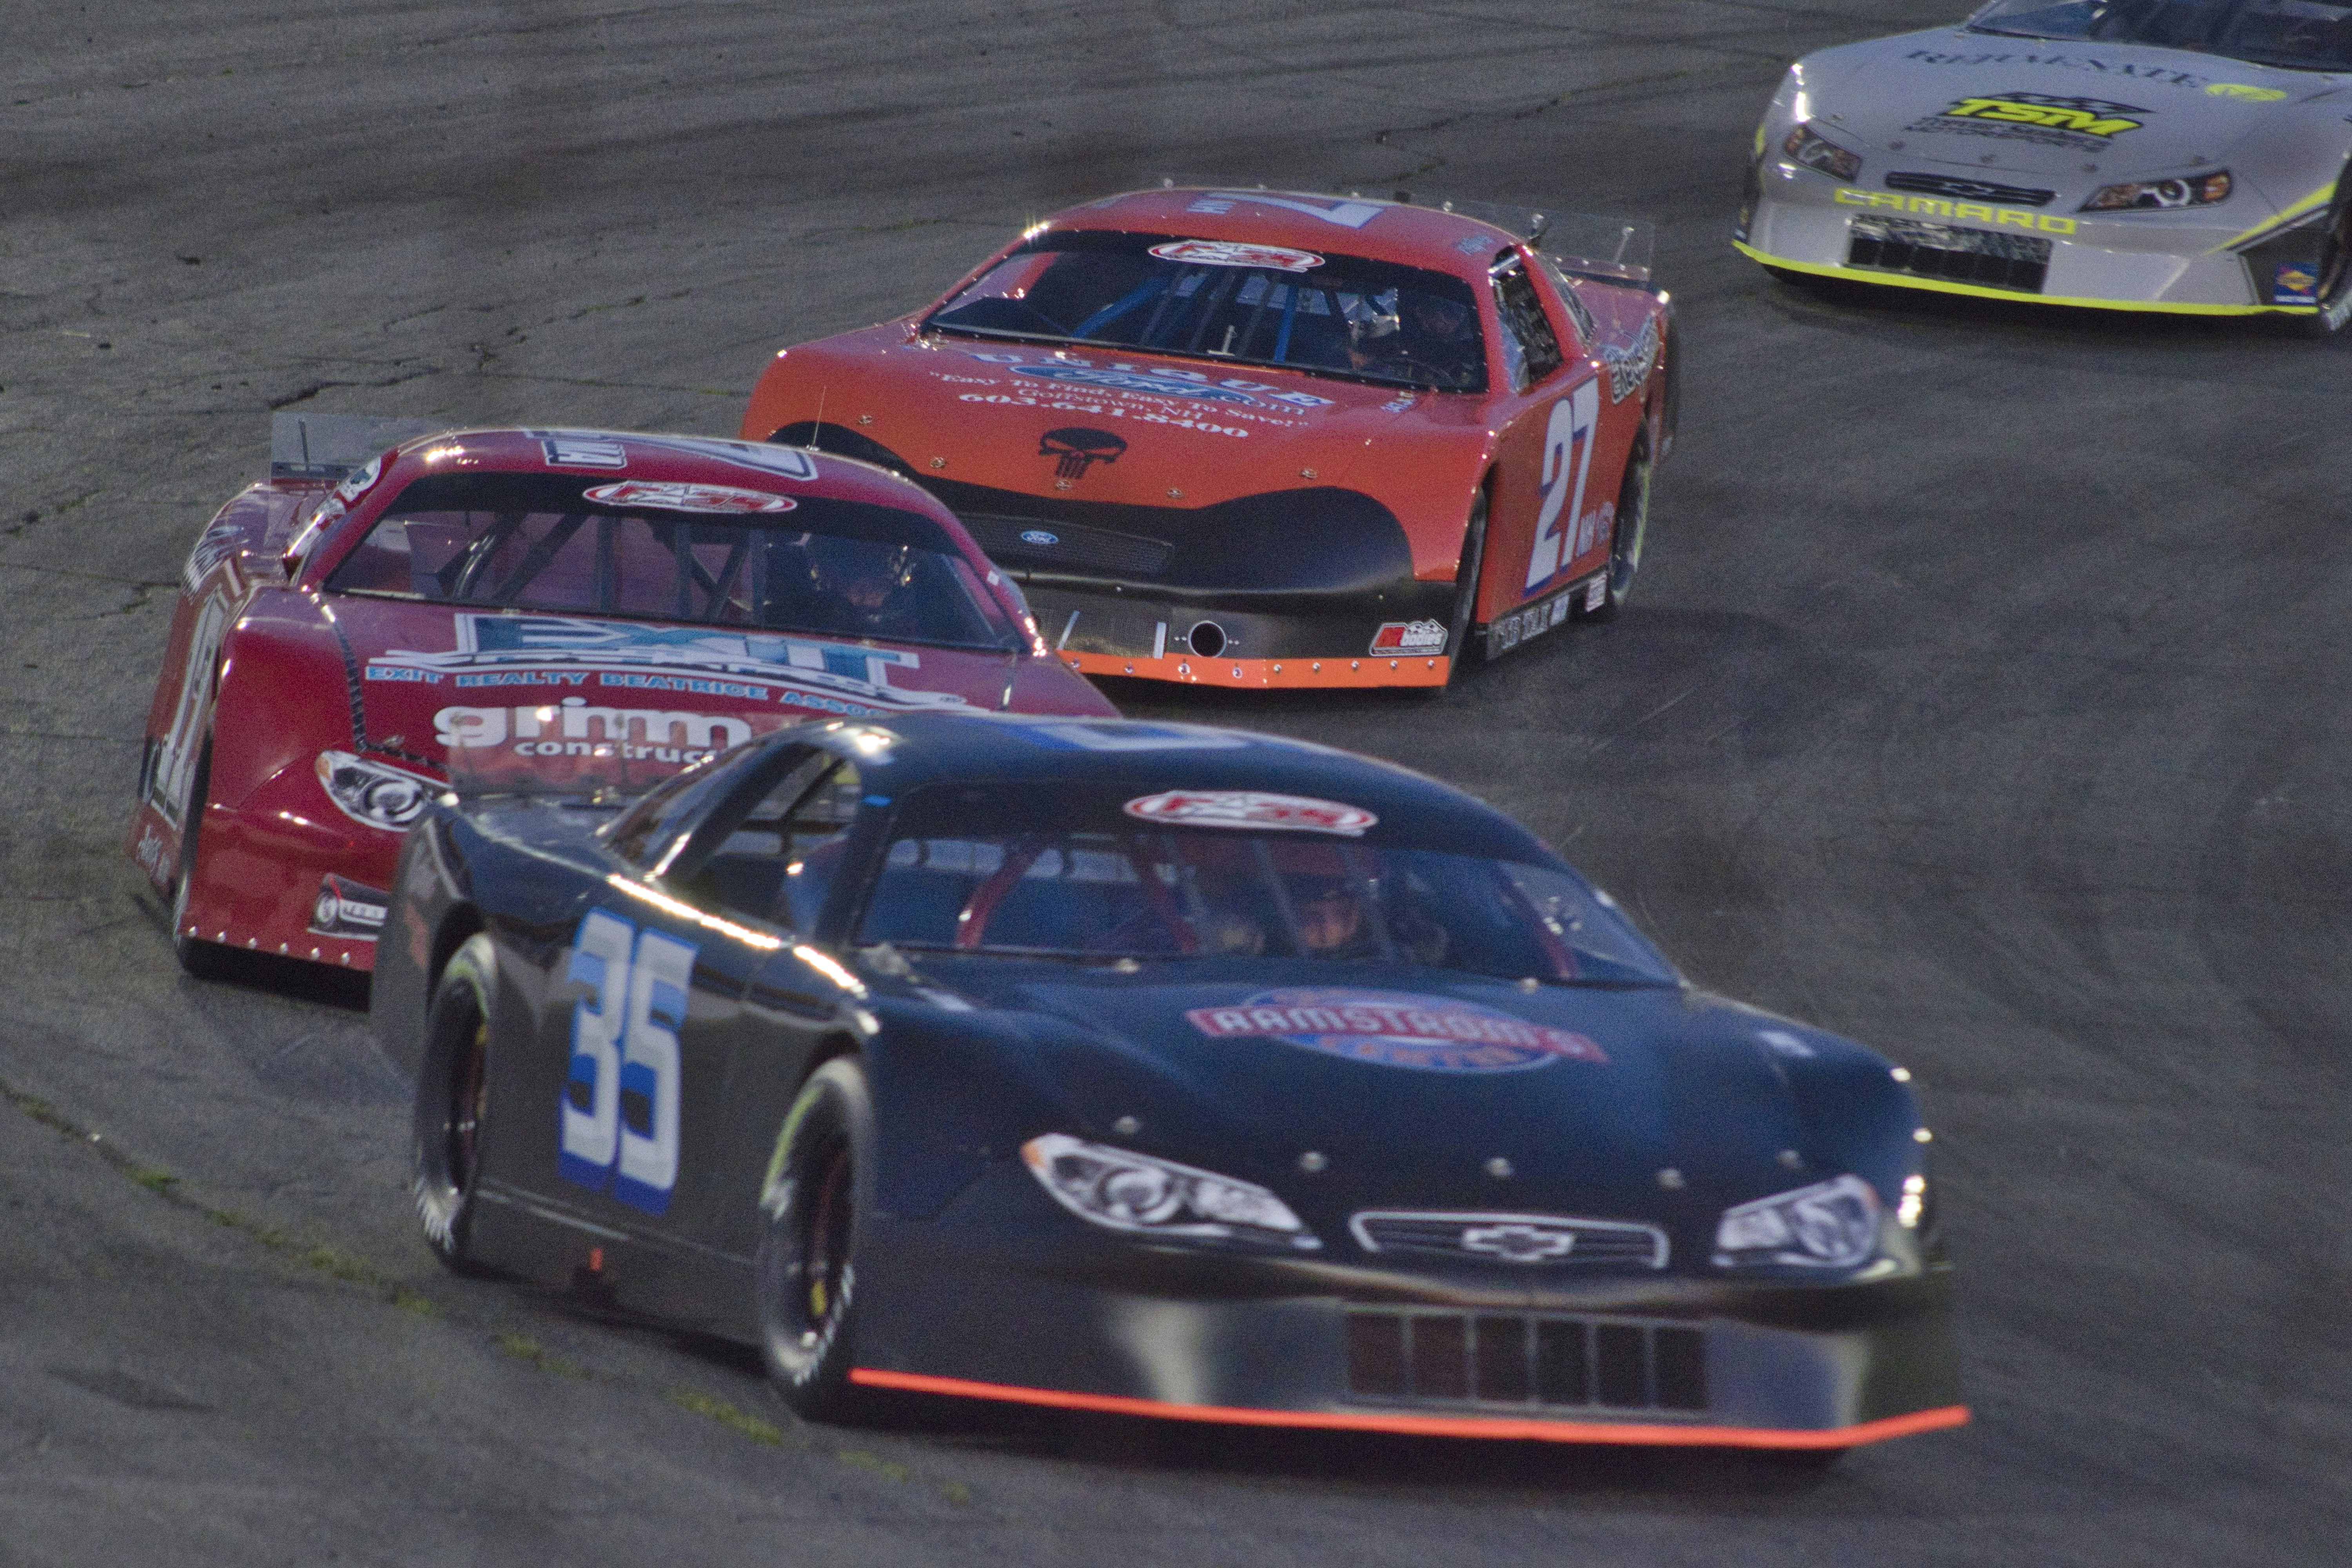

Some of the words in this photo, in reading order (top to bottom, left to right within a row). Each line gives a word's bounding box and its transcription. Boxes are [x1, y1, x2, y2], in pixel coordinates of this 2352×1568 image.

[1938, 97, 2145, 139] TSM
[1833, 187, 2077, 234] CAMARO
[969, 353, 1336, 407] UNIQUE
[1010, 379, 1039, 389] To
[1121, 391, 1180, 407] Easy
[1188, 401, 1218, 413] To
[958, 393, 1249, 437] 603.641.8400
[1161, 405, 1203, 420] NH
[1524, 376, 1600, 595] 27
[365, 666, 444, 684] EXIT
[456, 671, 589, 688] REALTY
[599, 672, 769, 700] BEATRICE
[433, 696, 751, 747] grimm
[559, 907, 700, 1200] 35
